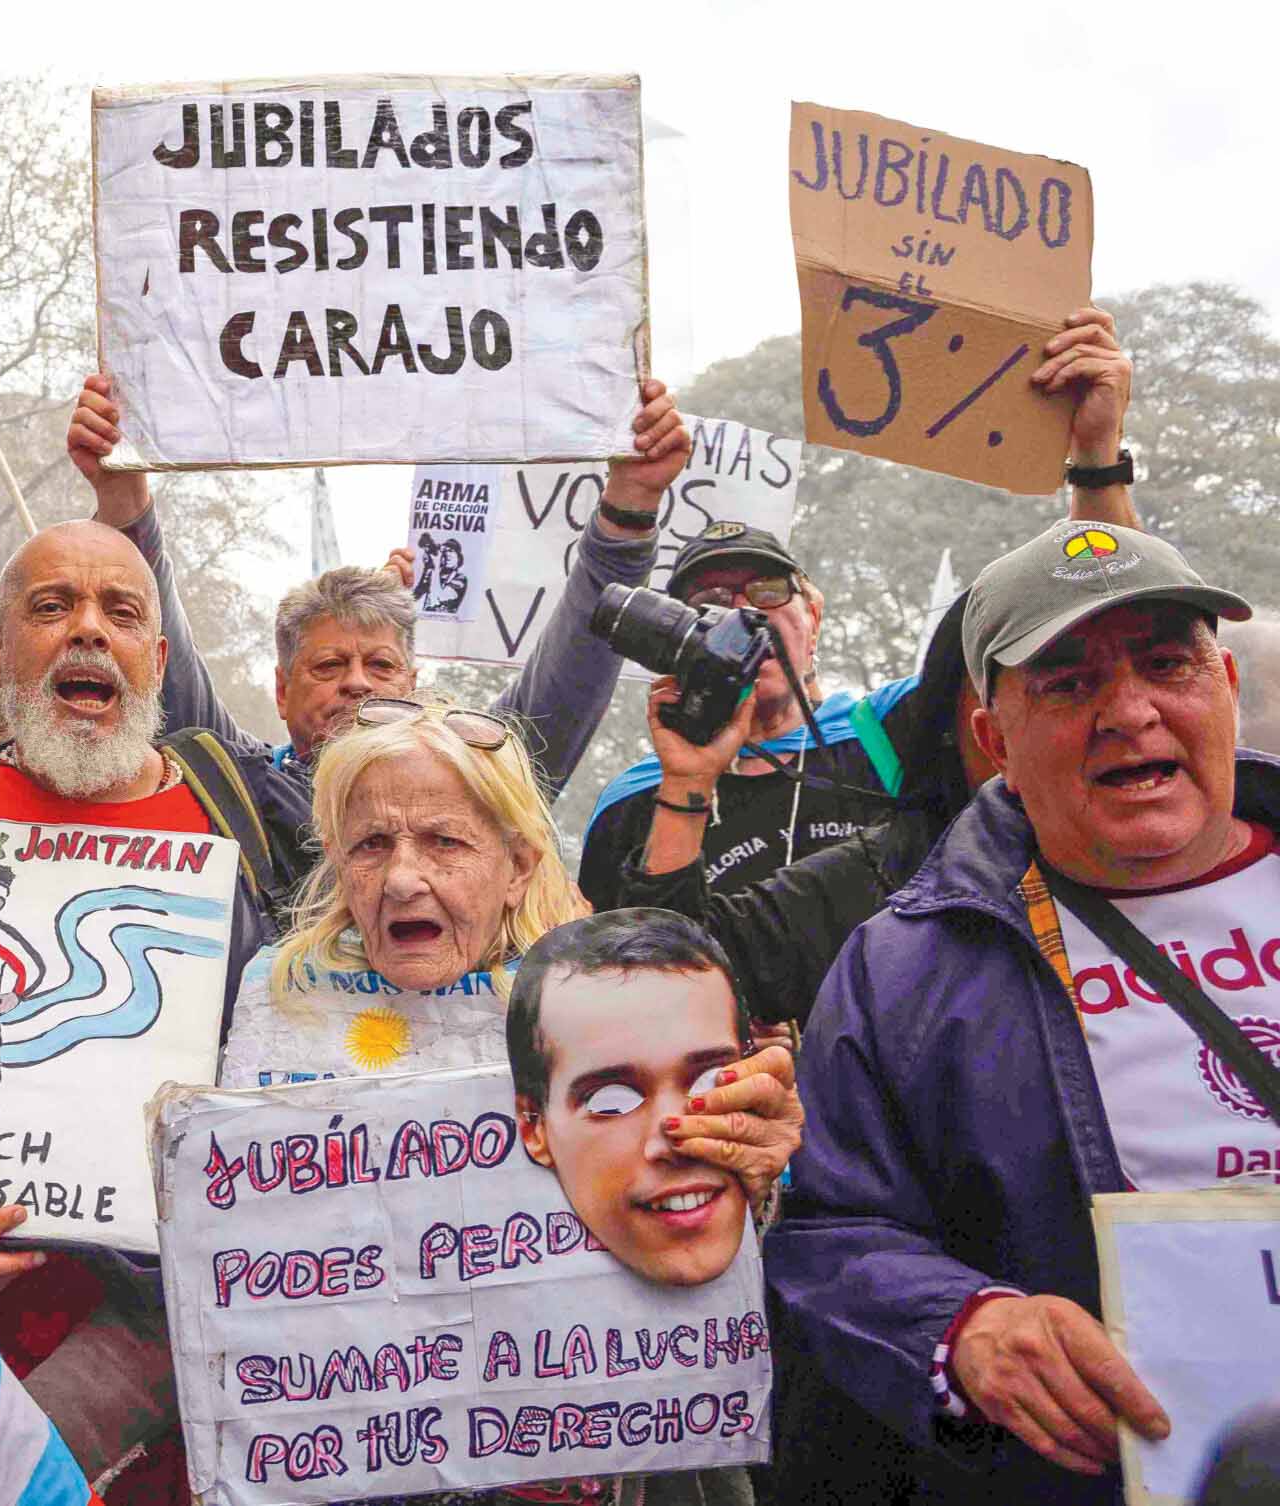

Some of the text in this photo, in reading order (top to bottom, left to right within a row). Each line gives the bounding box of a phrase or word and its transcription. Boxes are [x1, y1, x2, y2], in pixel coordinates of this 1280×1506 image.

[897, 272, 933, 297] EL
[220, 304, 513, 379] CARAJO
[414, 500, 430, 511] DE
[416, 479, 489, 503] ARMA
[413, 511, 486, 533] MASIVA
[214, 1245, 386, 1309] PODES
[484, 1331, 521, 1382] A
[605, 1311, 771, 1378] LUCHA
[246, 1424, 349, 1484] POR
[468, 1390, 754, 1460] DERECHOS
